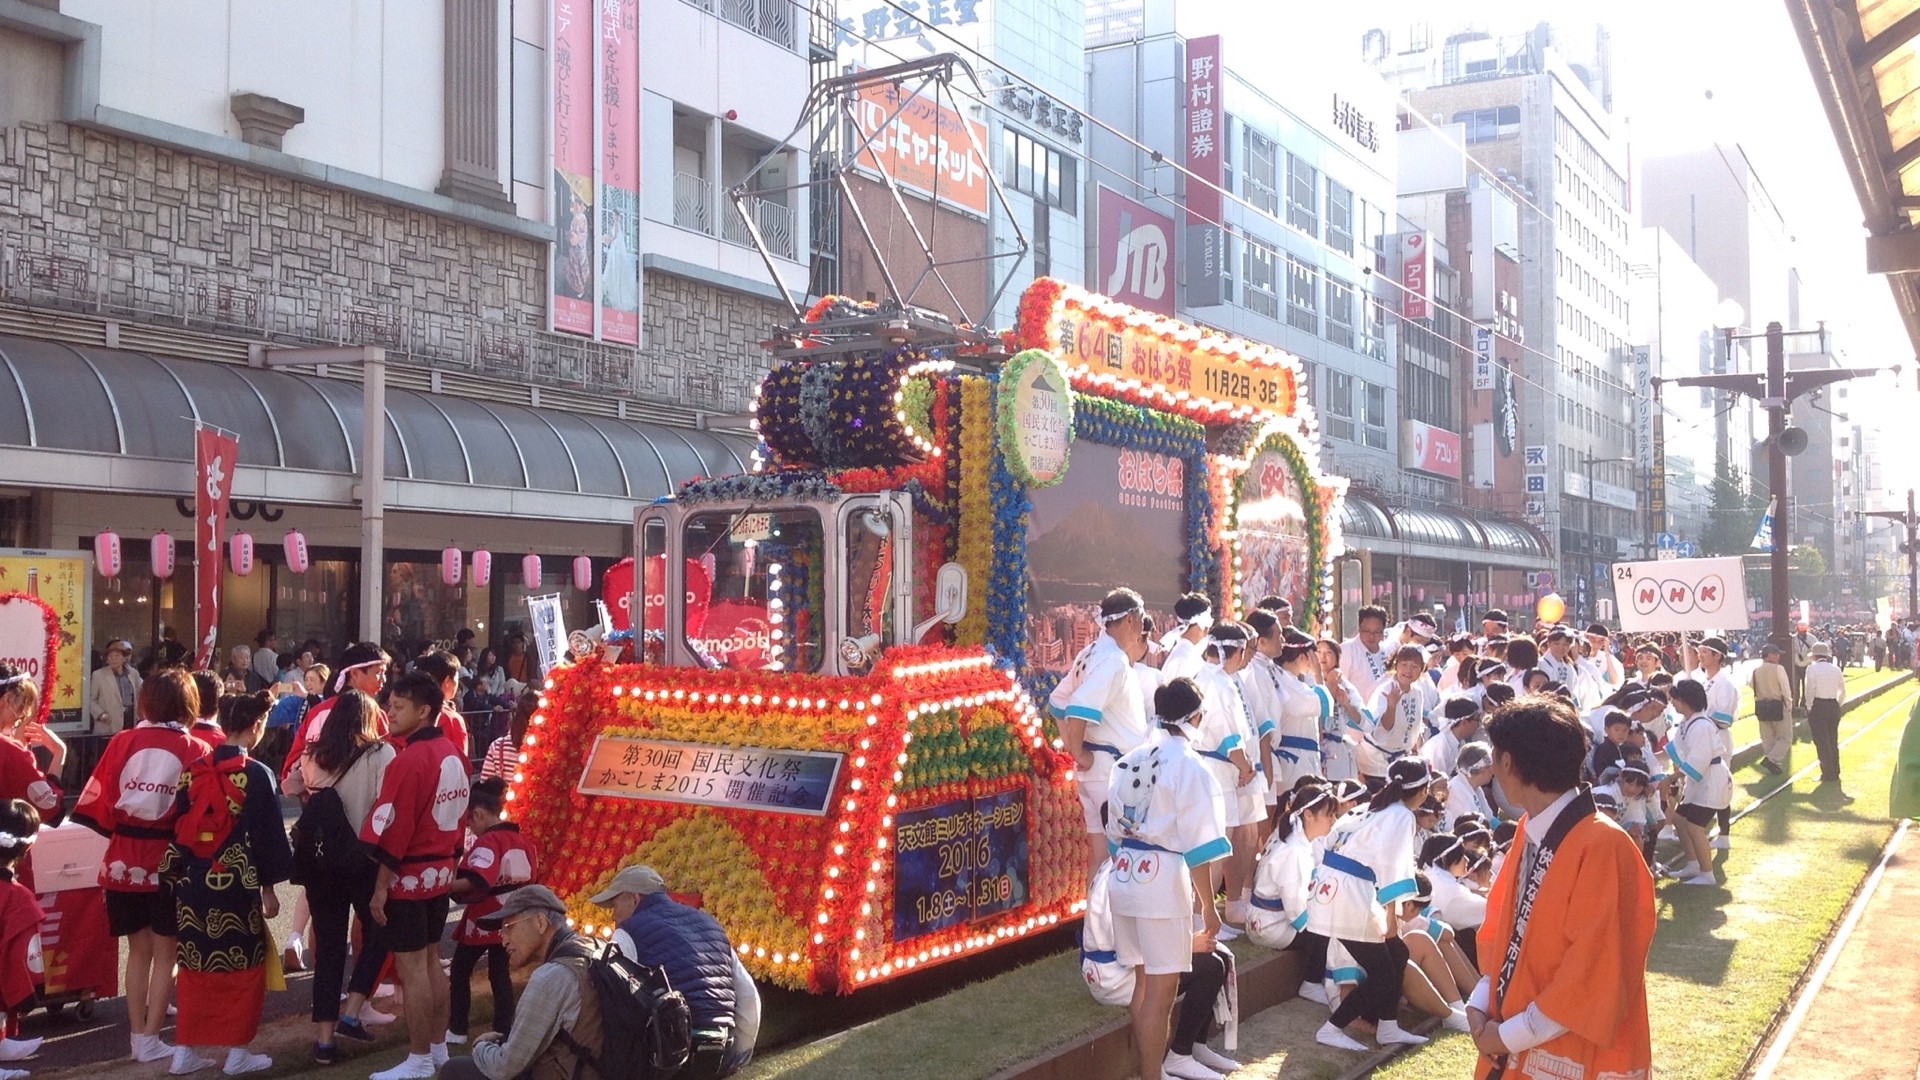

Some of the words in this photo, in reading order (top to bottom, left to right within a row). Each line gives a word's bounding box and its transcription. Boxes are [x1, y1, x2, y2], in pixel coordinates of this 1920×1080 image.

[885, 87, 962, 133] キッシングネット
[1191, 55, 1214, 159] 野村證券
[891, 117, 984, 188] キャネット
[1107, 211, 1168, 300] JTB
[1204, 228, 1213, 278] NOMURA
[1408, 264, 1422, 303] アコム
[1060, 319, 1122, 370] 第64回
[1131, 342, 1191, 389] おはら祭
[1477, 379, 1490, 387] 5F
[1118, 447, 1183, 498] おはら祭
[1617, 567, 1632, 580] 24
[1639, 586, 1716, 603] NHK
[599, 768, 715, 798] かごしま2015
[622, 744, 683, 768] 第30回
[692, 751, 802, 782] 国民文化祭
[898, 802, 1023, 853] 天文館ミリオネーション
[939, 833, 991, 878] 2016
[1113, 856, 1151, 874] HK
